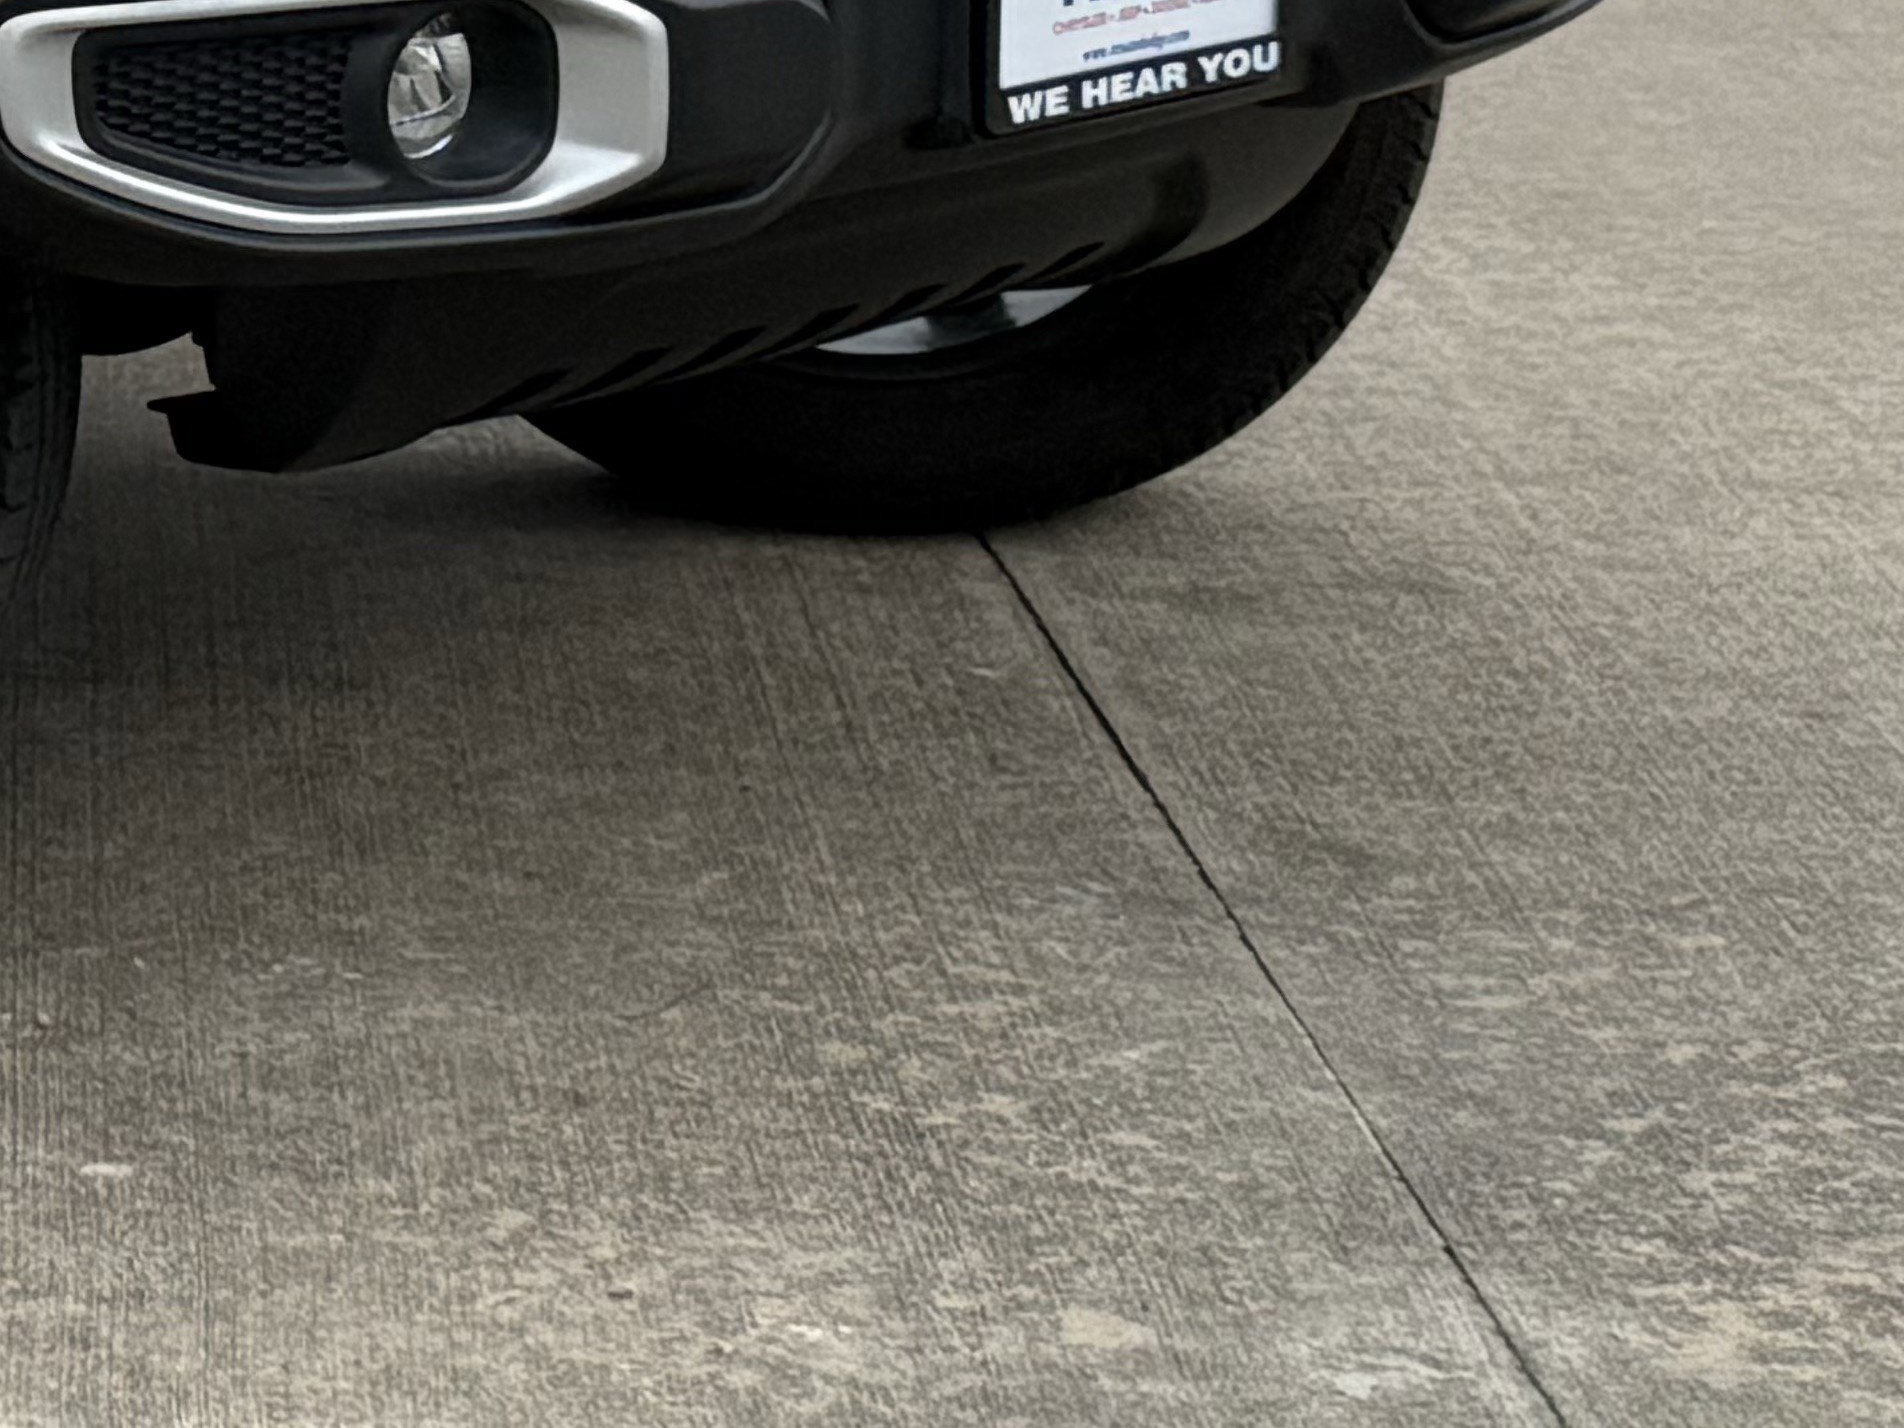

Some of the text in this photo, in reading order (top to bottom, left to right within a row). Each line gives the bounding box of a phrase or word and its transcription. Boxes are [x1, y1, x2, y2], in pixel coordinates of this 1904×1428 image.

[1008, 84, 1070, 124] WE
[1081, 61, 1188, 109] HEAR
[1197, 41, 1281, 83] YOU
